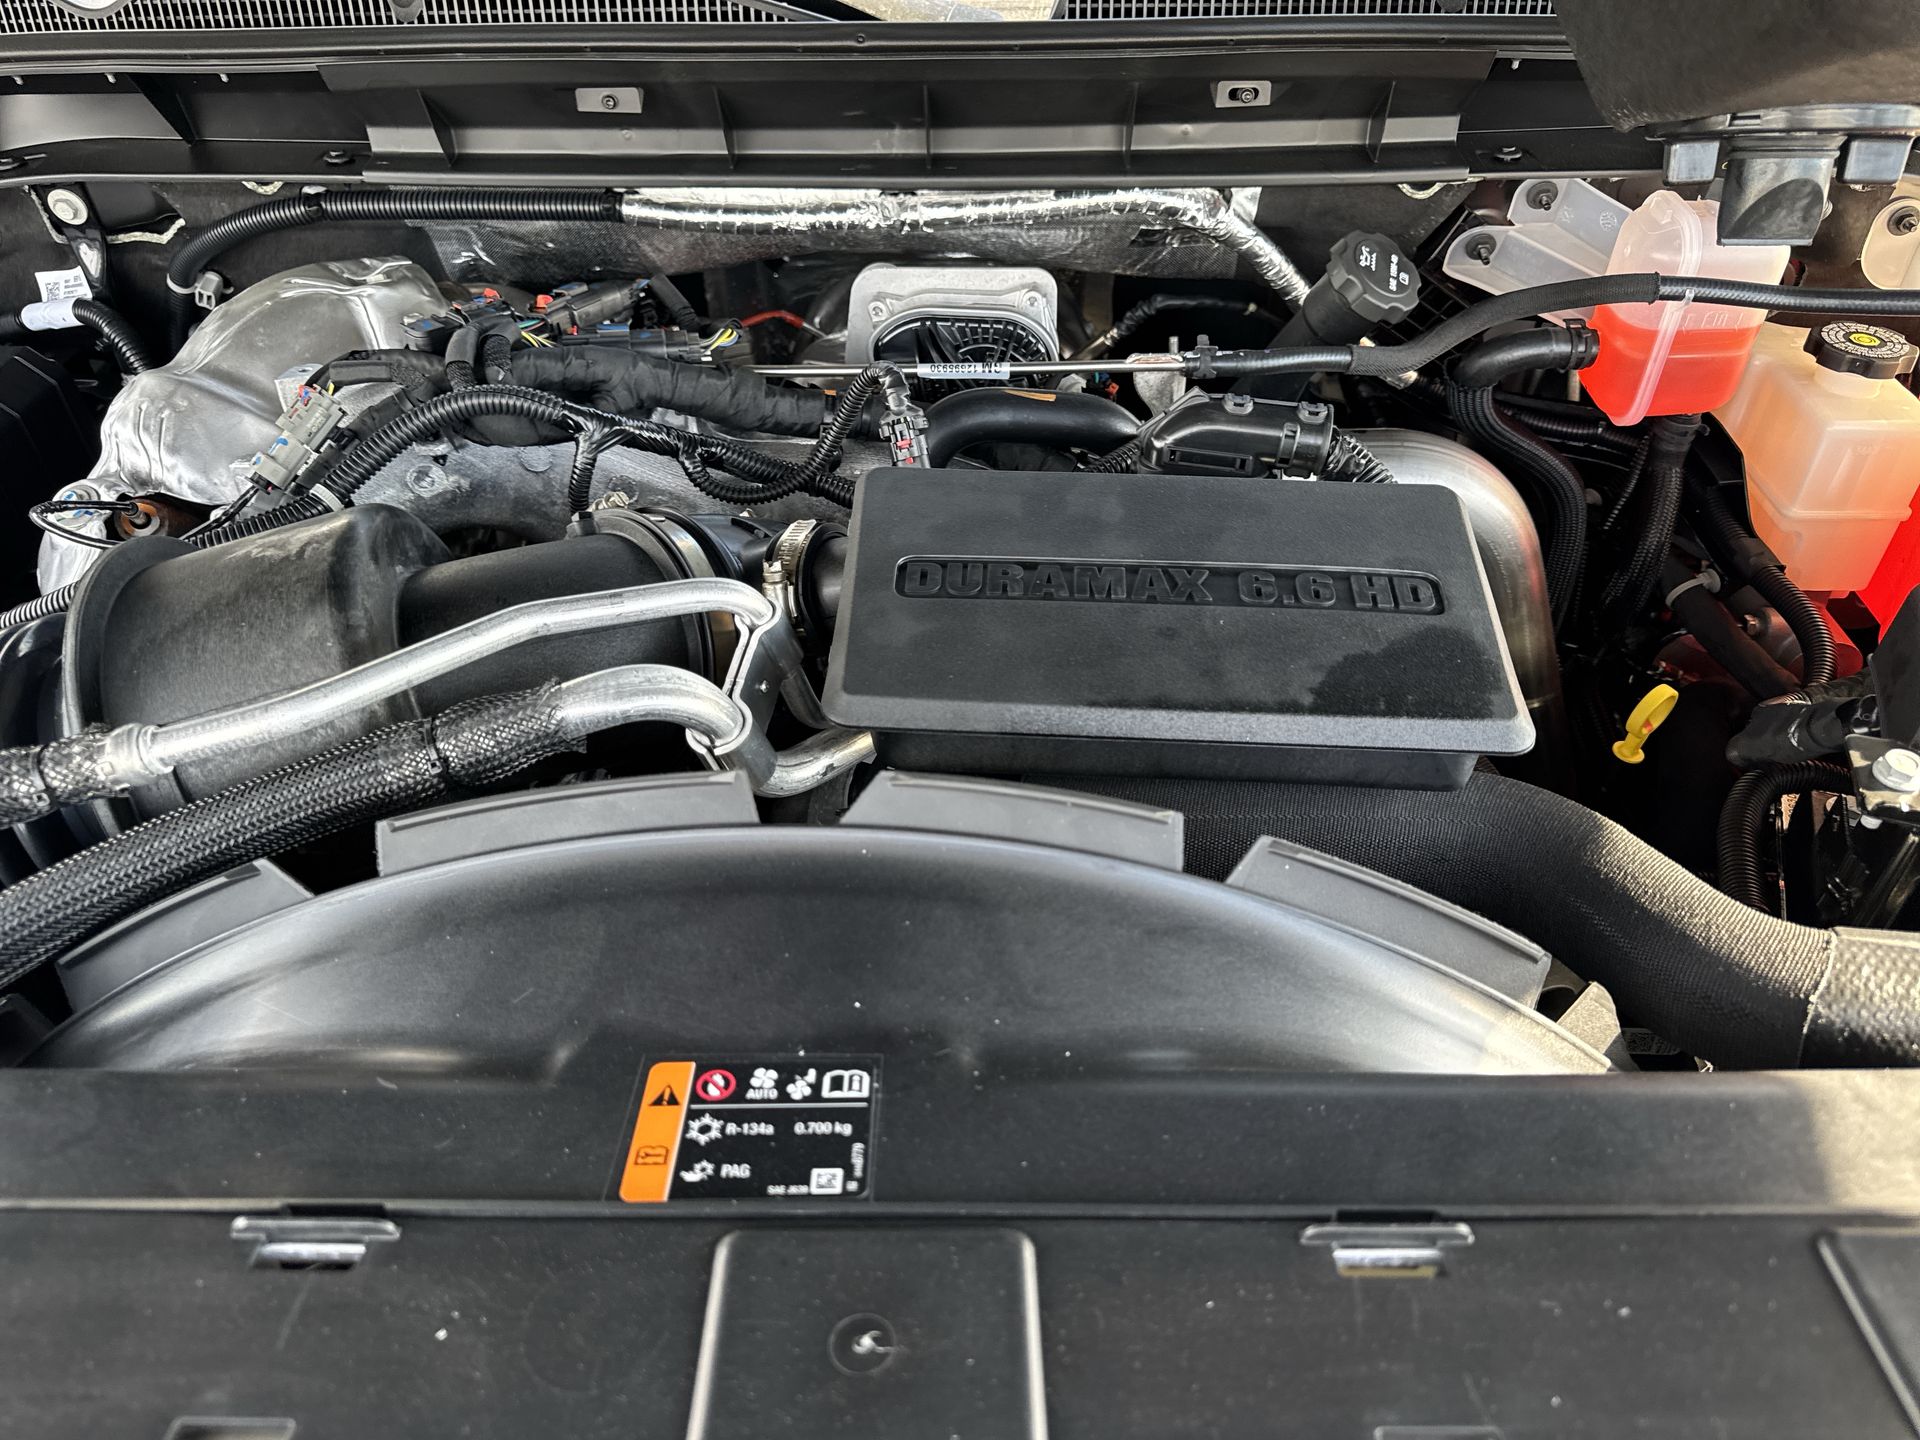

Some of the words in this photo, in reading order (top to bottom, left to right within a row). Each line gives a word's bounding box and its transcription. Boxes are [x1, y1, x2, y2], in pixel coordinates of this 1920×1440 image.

[981, 362, 1002, 374] GM
[903, 562, 1213, 602] DURAMAX
[1238, 570, 1336, 607] 6.6
[1351, 573, 1437, 610] HD
[745, 1088, 778, 1100] AUTO
[725, 1123, 775, 1135] R-134a
[794, 1122, 832, 1135] 0.700
[834, 1121, 853, 1137] kg
[720, 1163, 751, 1178] PAG
